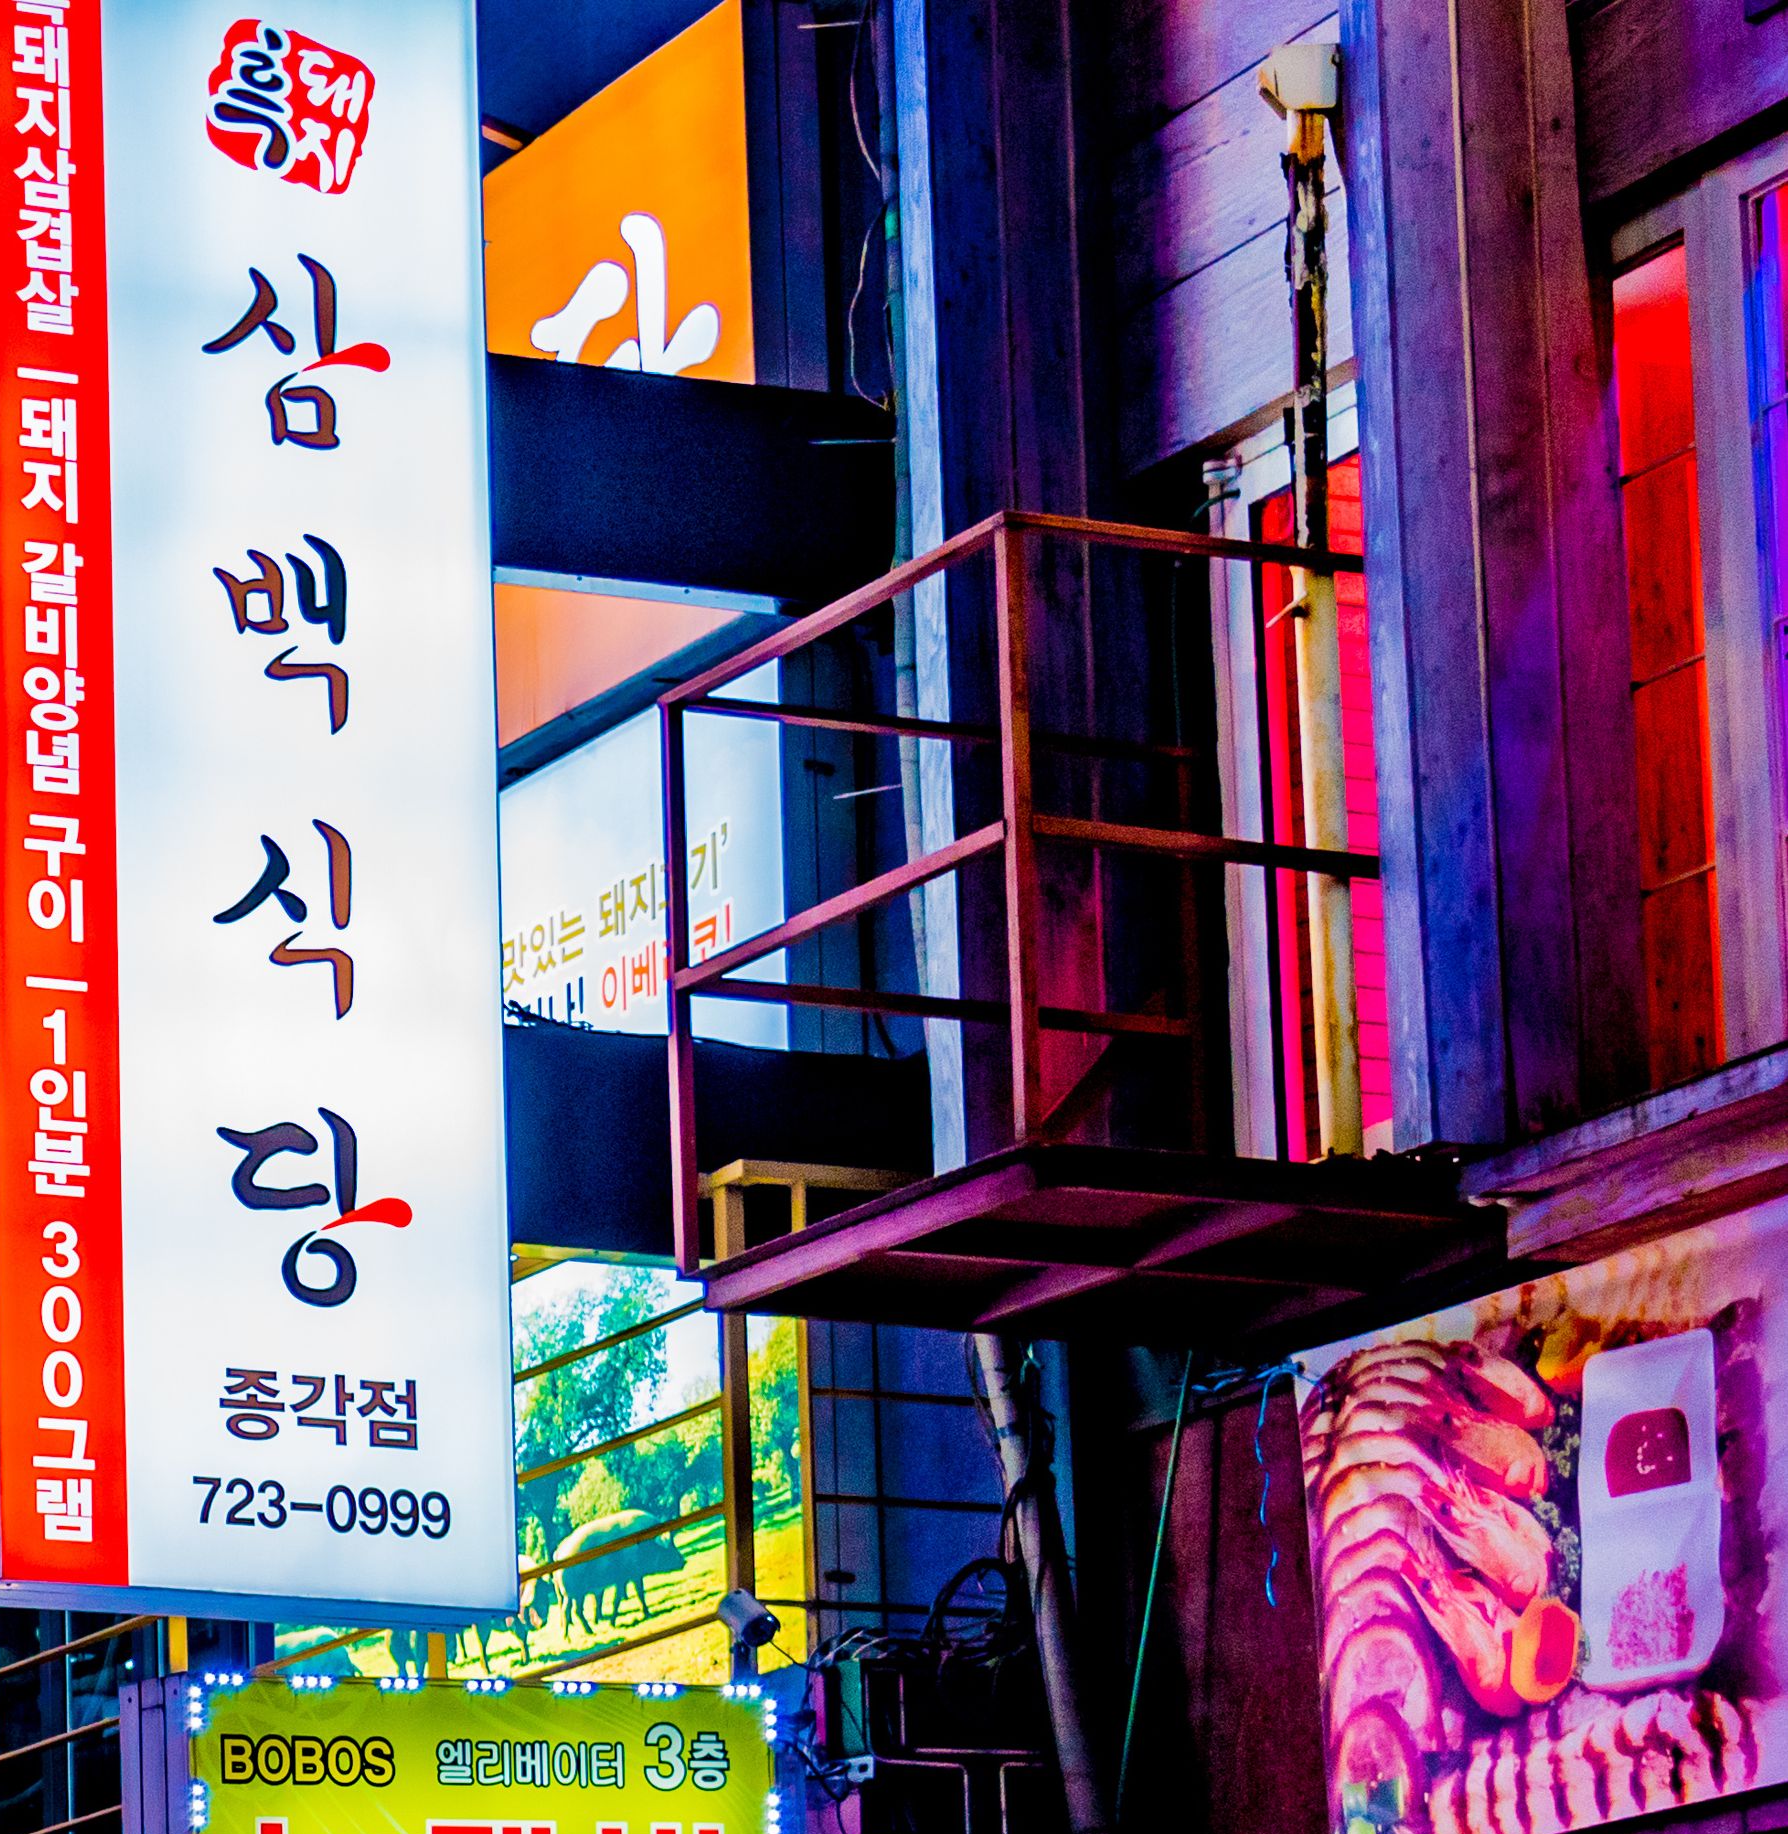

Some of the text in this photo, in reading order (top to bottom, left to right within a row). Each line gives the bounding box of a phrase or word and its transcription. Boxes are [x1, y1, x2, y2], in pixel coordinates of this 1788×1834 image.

[202, 252, 414, 1308] 삼백식당
[19, 396, 97, 1544] 돼지 갈비양념 구이 1인분 300그램
[503, 909, 586, 993] 맛있는
[218, 1367, 420, 1452] 종각점
[192, 1475, 451, 1540] 723-0999
[220, 1721, 731, 1793] BOBOS 엘리베이터 3층
